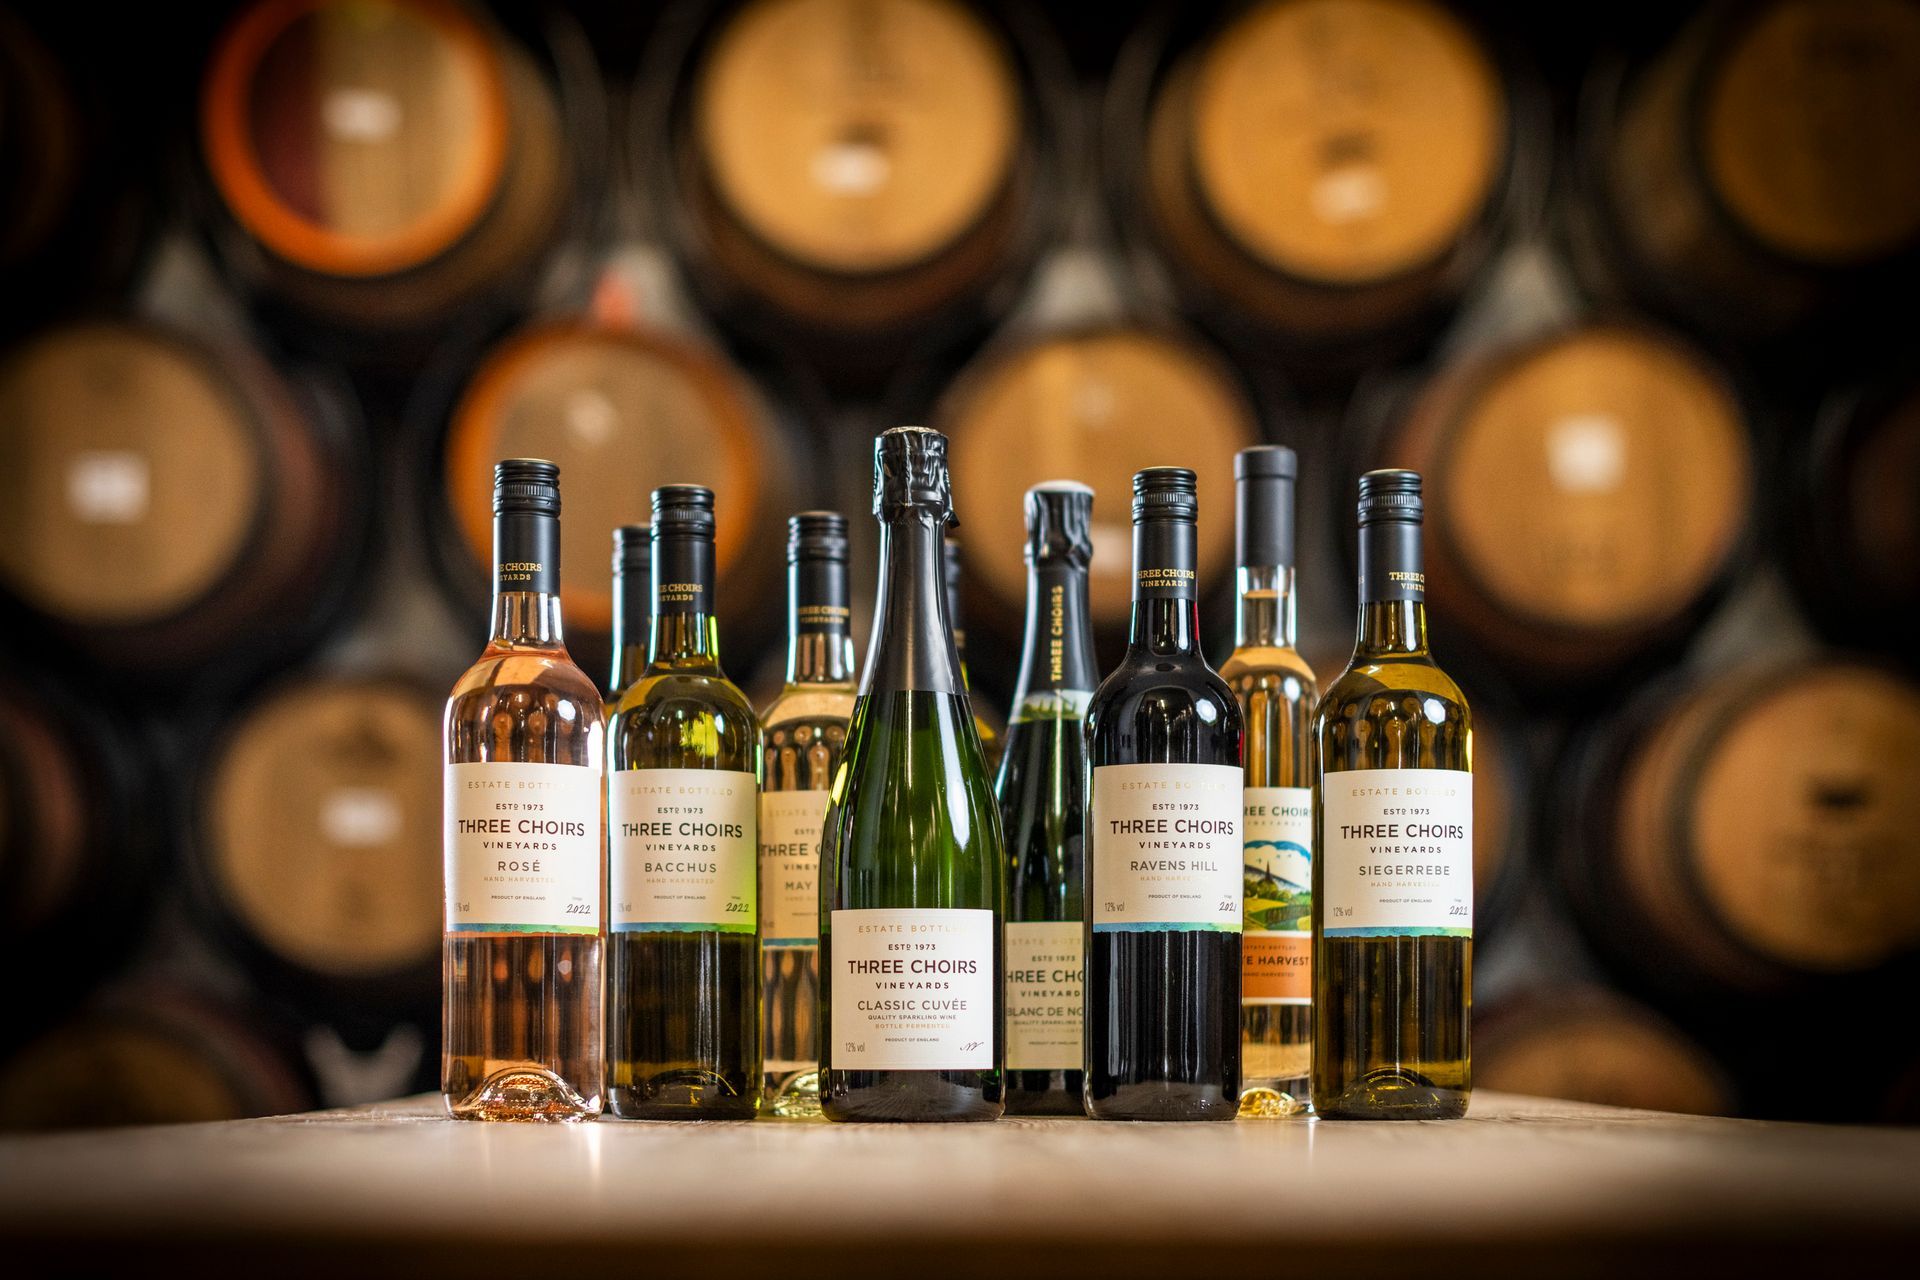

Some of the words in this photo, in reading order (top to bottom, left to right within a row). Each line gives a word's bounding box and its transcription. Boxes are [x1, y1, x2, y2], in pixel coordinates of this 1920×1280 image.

[505, 563, 542, 572] CHOIRS
[1137, 569, 1161, 579] HREE
[1162, 568, 1194, 579] CHOIRS
[1388, 571, 1419, 581] THREE
[668, 583, 703, 592] CHOIRS
[1050, 585, 1063, 637] CHOIRS
[1050, 639, 1063, 682] THREE
[468, 781, 510, 789] ESTATE
[1122, 781, 1167, 790] ESTATE
[630, 786, 671, 795] ESTATE
[1352, 788, 1398, 797] ESTATE
[683, 807, 704, 815] 1973
[1179, 803, 1199, 811] 1973
[458, 819, 511, 834] THREE
[518, 819, 585, 837] CHOIRS
[622, 822, 672, 837] THREE
[679, 822, 743, 838] CHOIRS
[1111, 819, 1168, 834] THREE
[1175, 819, 1234, 835] CHOIRS
[1340, 824, 1399, 839] THREE
[1406, 824, 1463, 839] CHOIRS
[483, 841, 557, 850] VINEYARDS
[645, 844, 716, 852] VINEYARDS
[1139, 841, 1211, 849] VINEYARDS
[1370, 846, 1442, 854] VINEYARDS
[497, 859, 540, 872] ROSÉ
[645, 862, 717, 873] BACCHUS
[1131, 860, 1186, 871] RAVENS
[1191, 861, 1218, 871] HILL
[1359, 865, 1450, 876] SIEGERREBE
[785, 881, 812, 891] MAY
[566, 904, 591, 914] 2022
[725, 902, 749, 913] 2022
[1117, 902, 1125, 912] vol
[1345, 906, 1353, 916] vol
[858, 925, 903, 933] ESTATE
[915, 943, 936, 951] 1973
[1258, 955, 1310, 966] HARVEST
[848, 960, 904, 974] THREE
[911, 960, 977, 974] CHOIRS
[1007, 970, 1046, 983] HREE
[876, 982, 950, 990] VINEYARDS
[1021, 990, 1081, 998] VINEYARD
[857, 1000, 915, 1011] CLASSIC
[922, 998, 967, 1011] CUVÉE
[1047, 1007, 1064, 1016] DE
[845, 1042, 856, 1053] 12%
[857, 1042, 866, 1053] vol
